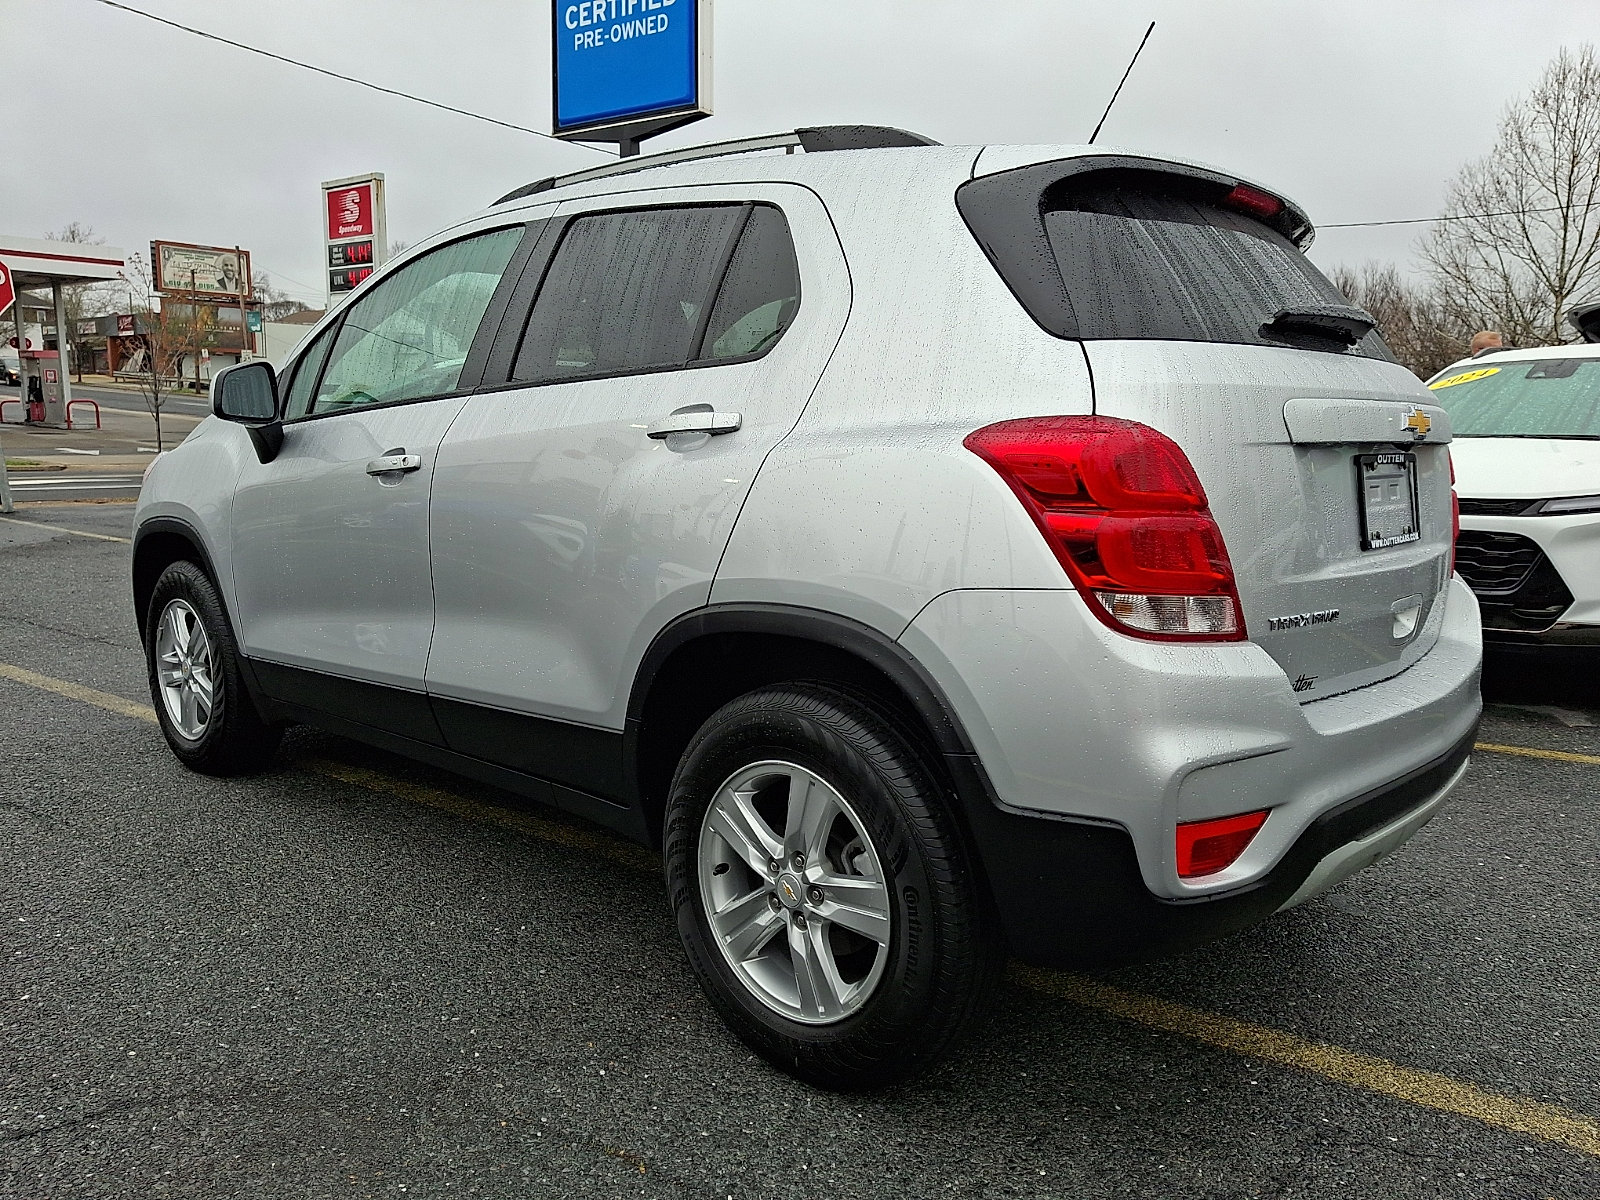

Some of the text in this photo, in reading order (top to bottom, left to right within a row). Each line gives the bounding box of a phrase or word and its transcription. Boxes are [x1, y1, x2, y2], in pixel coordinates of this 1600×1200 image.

[565, 0, 677, 30] CERTIFI
[574, 14, 669, 51] PRE-OWNED
[338, 224, 363, 235] Speedway
[1377, 454, 1405, 464] OUTTEN
